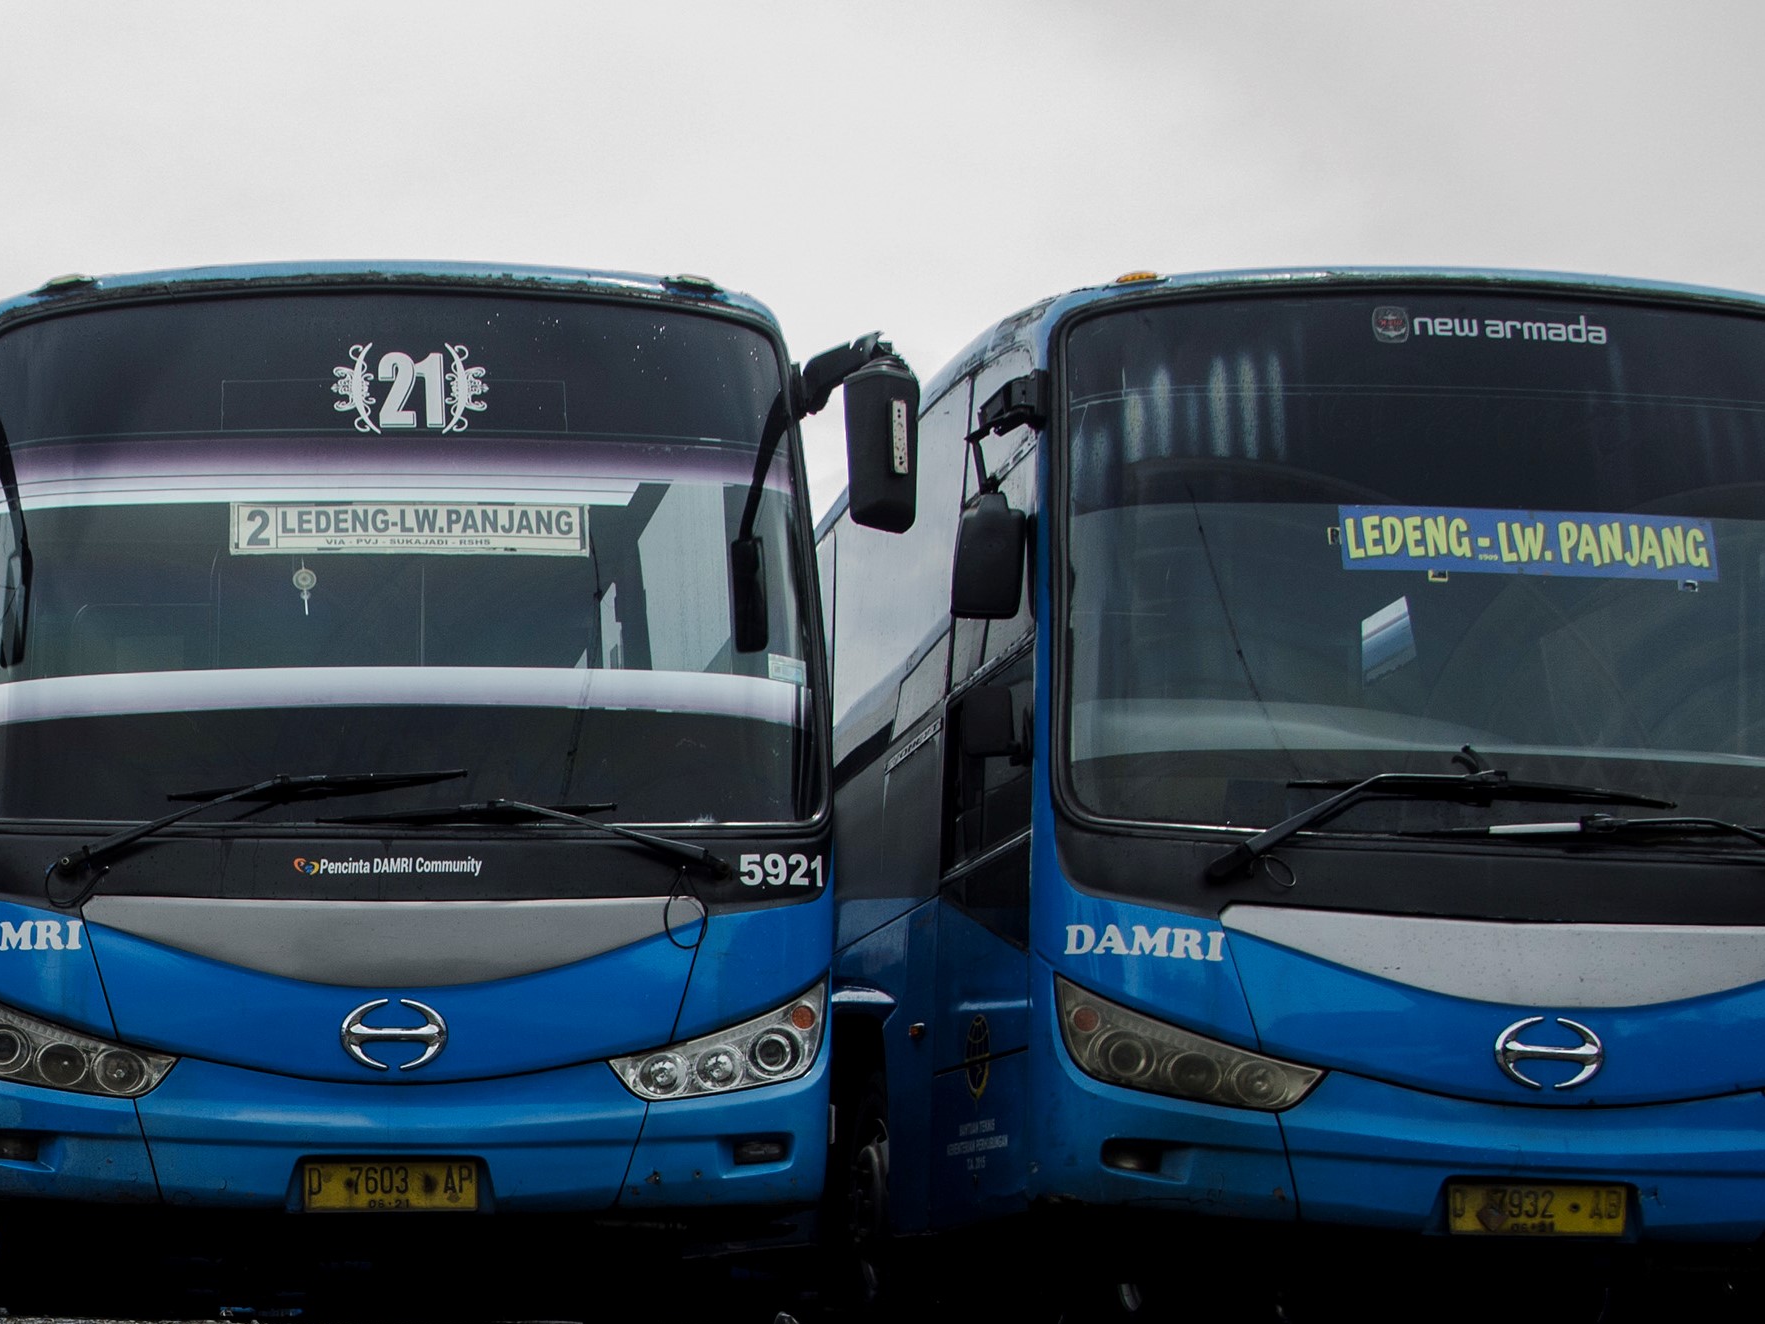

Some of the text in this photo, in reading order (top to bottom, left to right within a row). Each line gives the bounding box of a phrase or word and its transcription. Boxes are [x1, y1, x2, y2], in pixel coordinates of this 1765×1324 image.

[1413, 317, 1478, 336] new
[1484, 315, 1607, 344] armada
[378, 352, 446, 428] 21
[246, 509, 271, 546] 2
[281, 509, 574, 535] LEDENG-LW.PANJANG
[389, 538, 449, 546] SUKAJADI
[1345, 515, 1472, 559] LEDENG
[1497, 522, 1553, 563] LW.
[1558, 521, 1710, 569] PANJANG
[319, 856, 483, 877] Pencinta DAMRI Community
[739, 853, 823, 887] 5921
[1064, 924, 1225, 961] DAMRI
[308, 1165, 473, 1195] D 7603 AP
[1452, 1189, 1465, 1218] D
[1492, 1189, 1555, 1219] 7932
